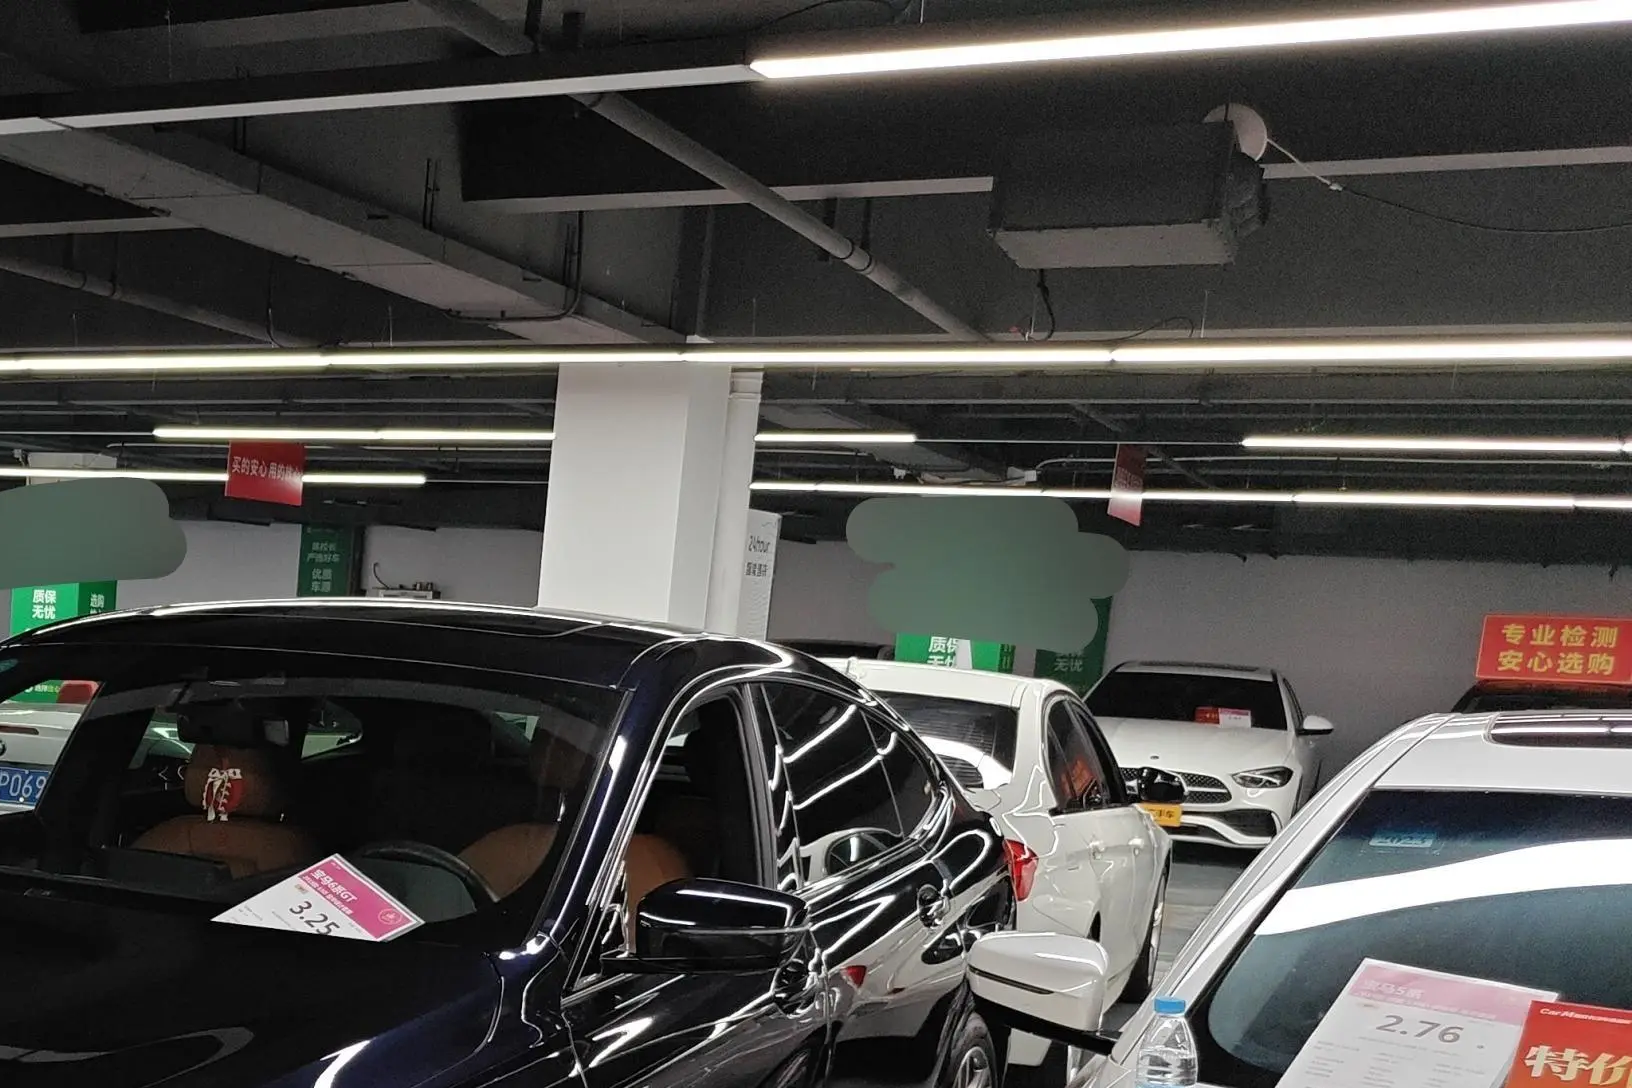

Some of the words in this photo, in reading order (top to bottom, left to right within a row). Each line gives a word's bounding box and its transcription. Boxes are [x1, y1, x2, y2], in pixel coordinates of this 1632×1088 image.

[32, 589, 57, 604] 质保
[32, 605, 56, 619] 无忧
[1501, 623, 1619, 648] 专业检测
[1497, 649, 1615, 676] 安心选购
[289, 900, 341, 935] 3.25
[1375, 1014, 1465, 1043] 2.76
